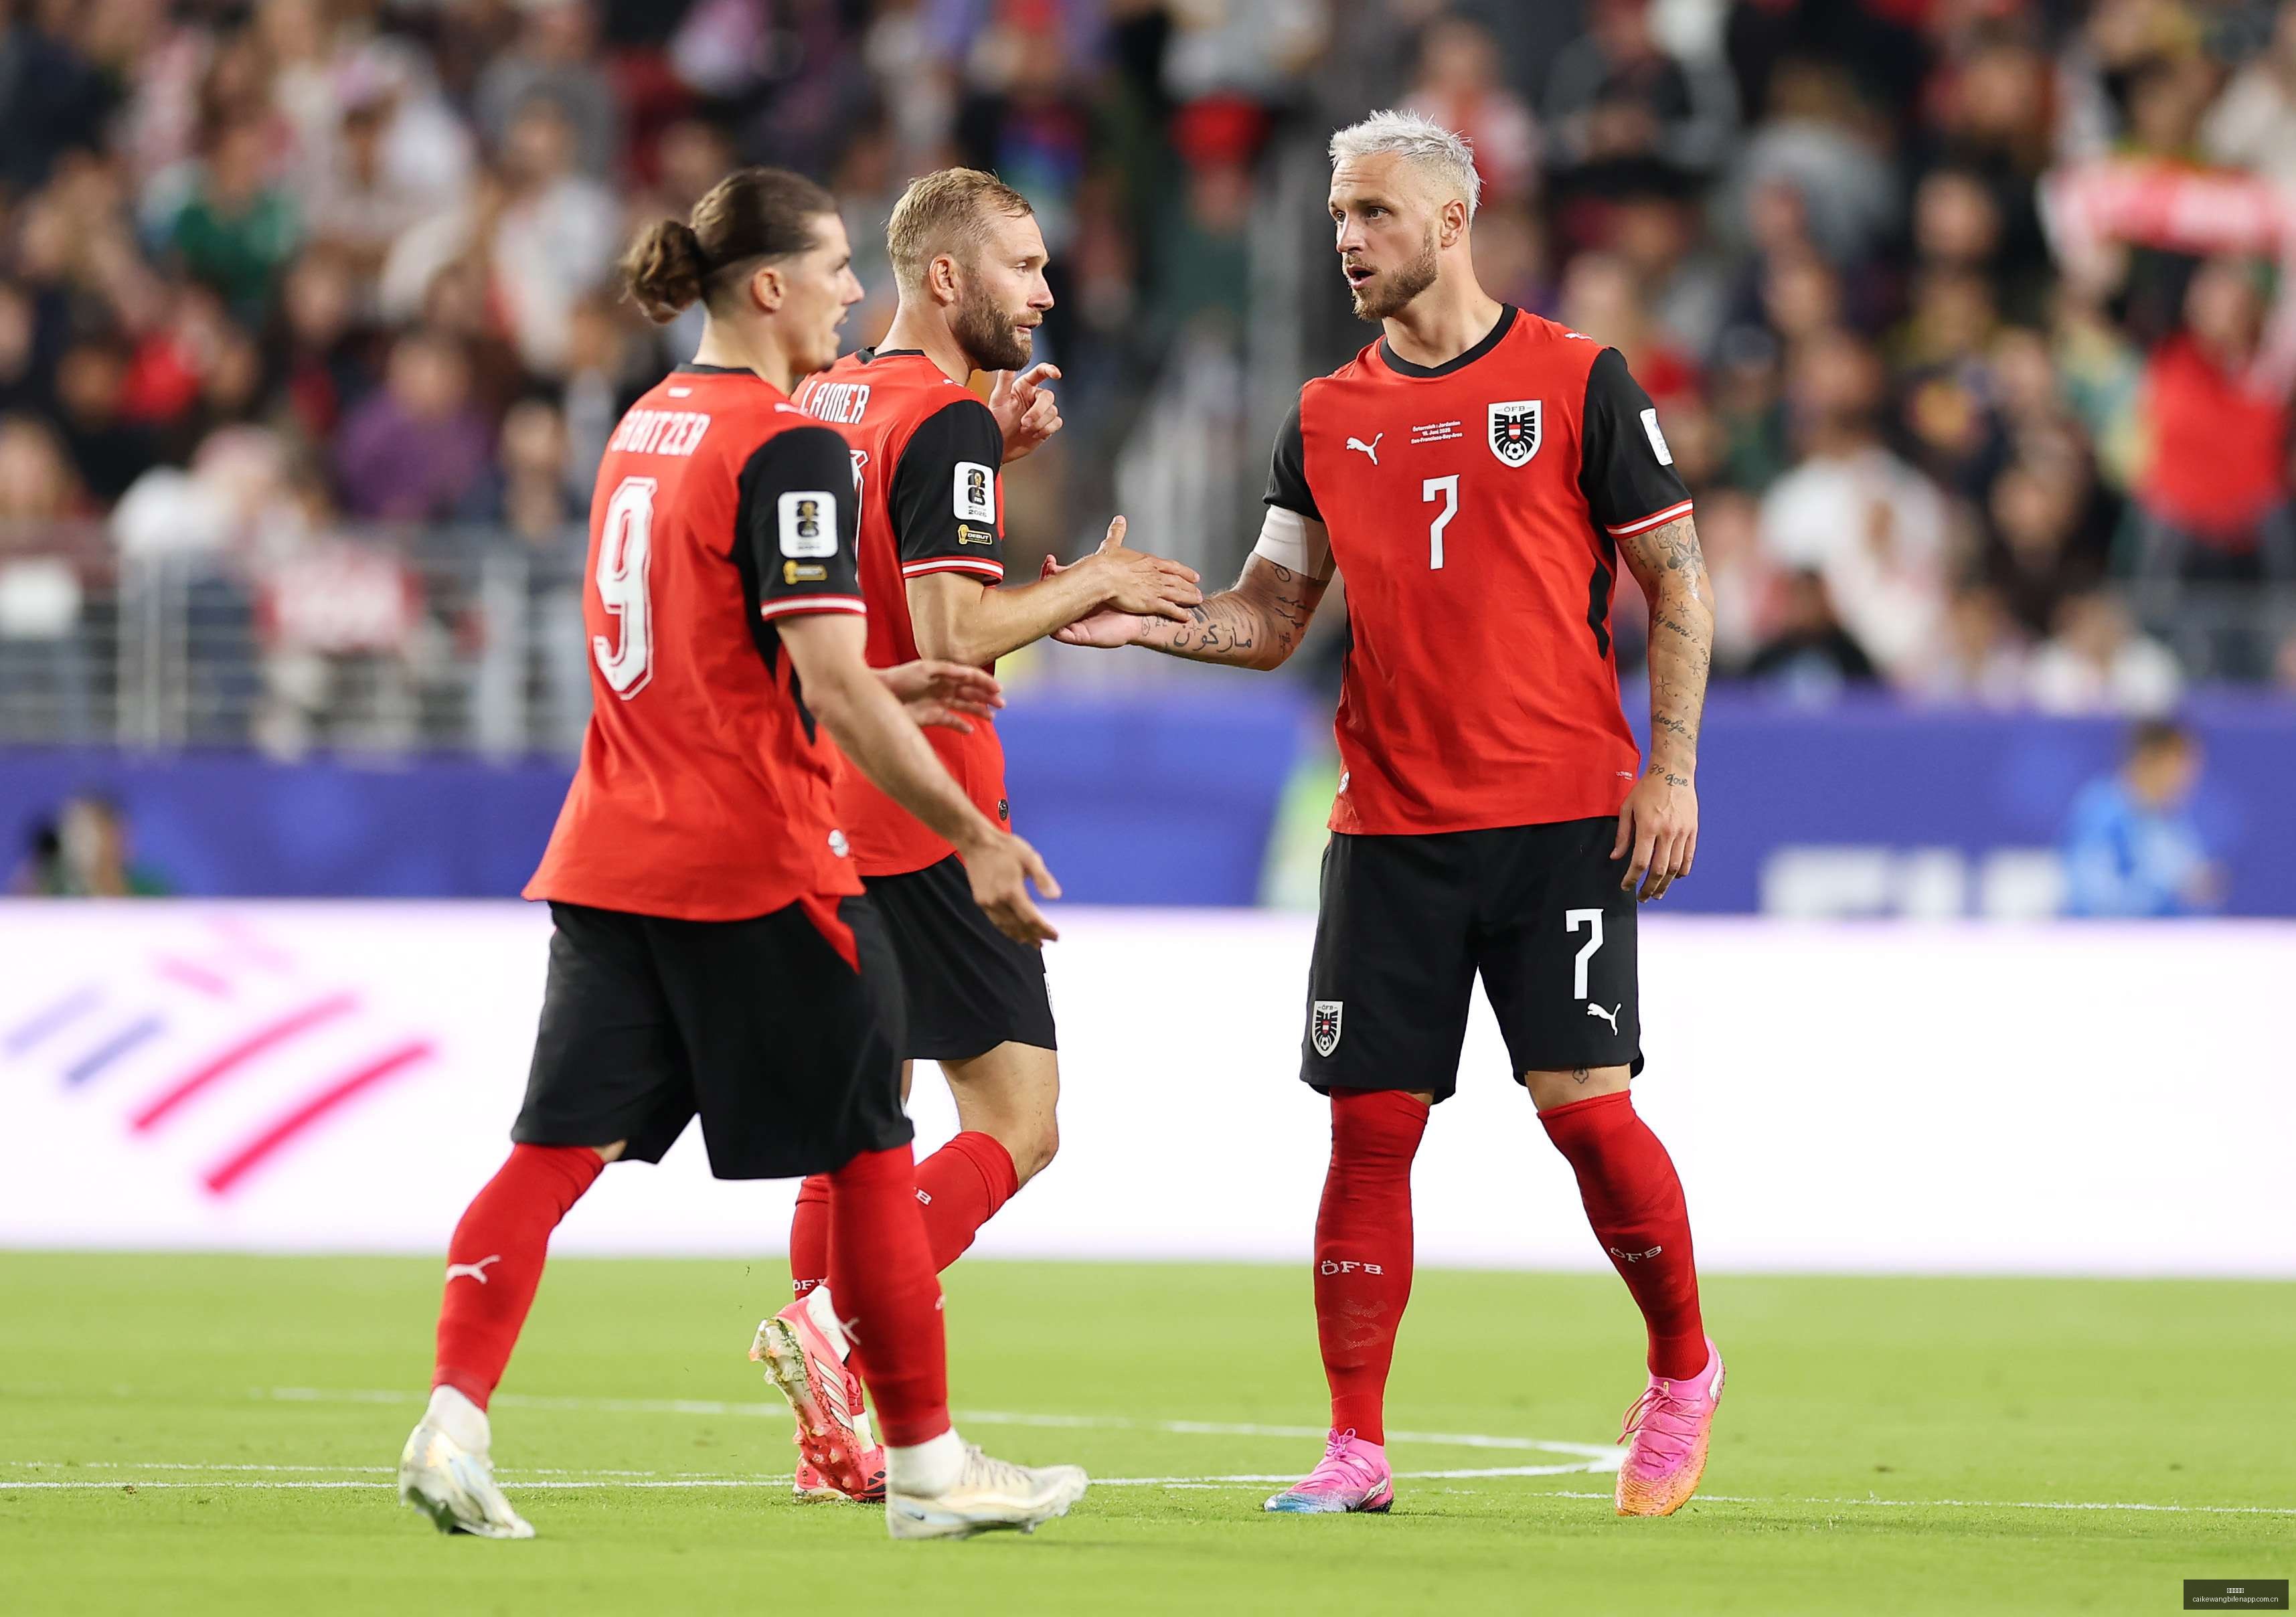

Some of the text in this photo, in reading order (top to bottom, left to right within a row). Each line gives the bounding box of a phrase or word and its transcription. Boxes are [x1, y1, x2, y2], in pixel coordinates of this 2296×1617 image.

[799, 380, 870, 425] LAIMER
[1422, 474, 1461, 570] 7
[593, 476, 658, 701] 9
[1565, 908, 1605, 1000] 7
[1610, 1246, 1662, 1263] ÖFB
